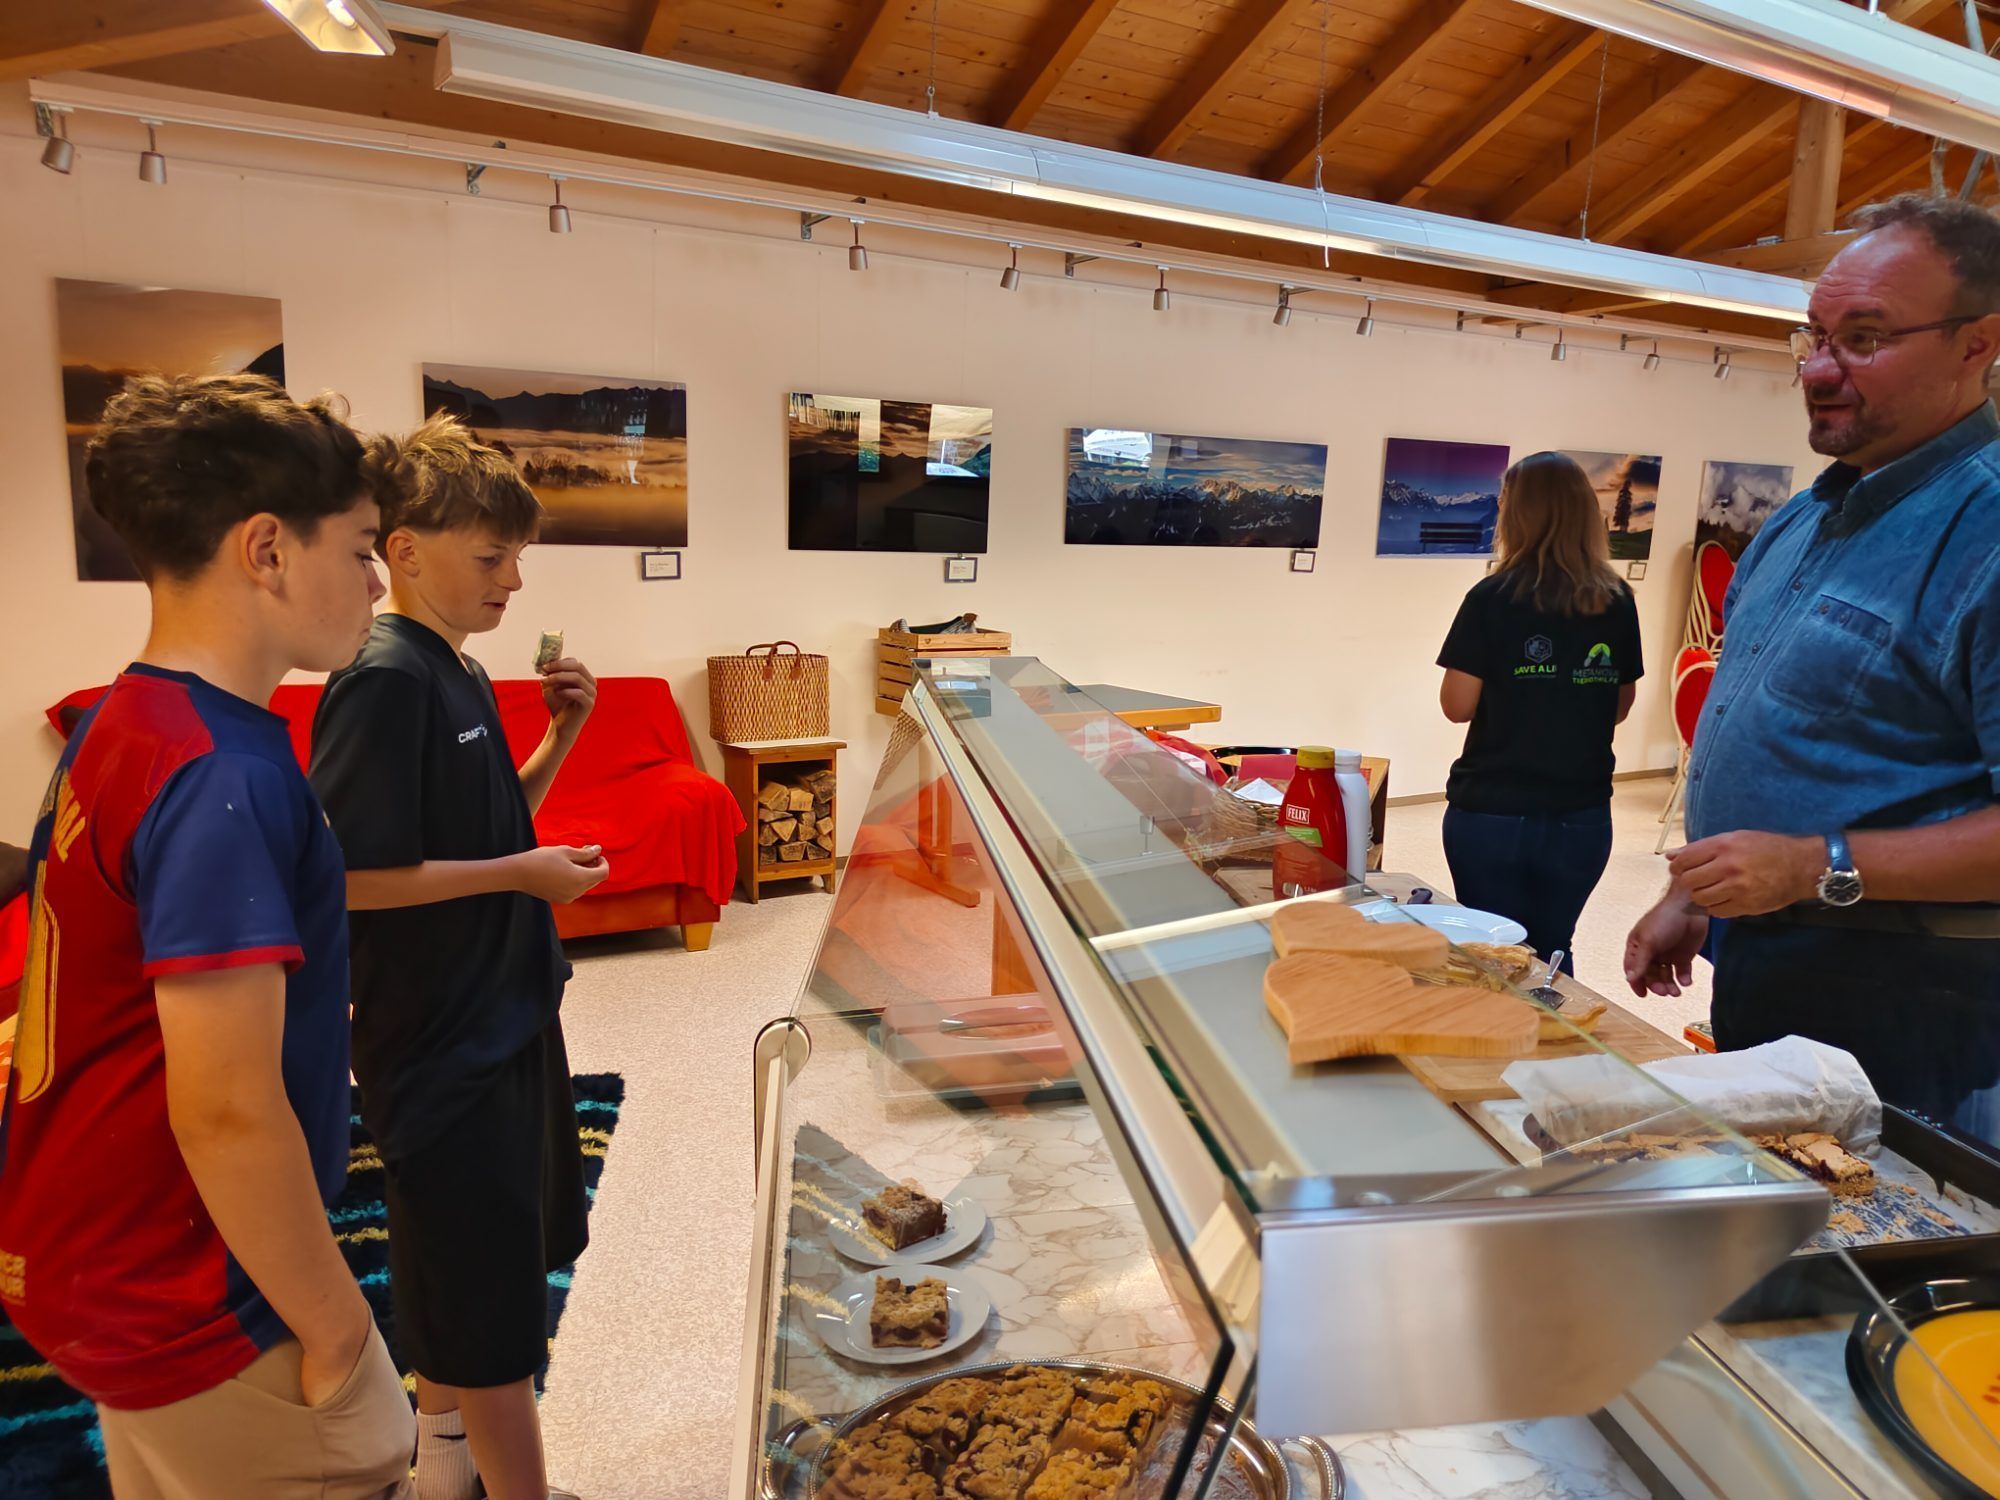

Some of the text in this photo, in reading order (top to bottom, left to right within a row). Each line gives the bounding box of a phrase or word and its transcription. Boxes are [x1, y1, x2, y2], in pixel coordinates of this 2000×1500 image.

[1513, 664, 1536, 676] SAVE
[1538, 664, 1545, 673] A
[1287, 807, 1308, 822] FELIX
